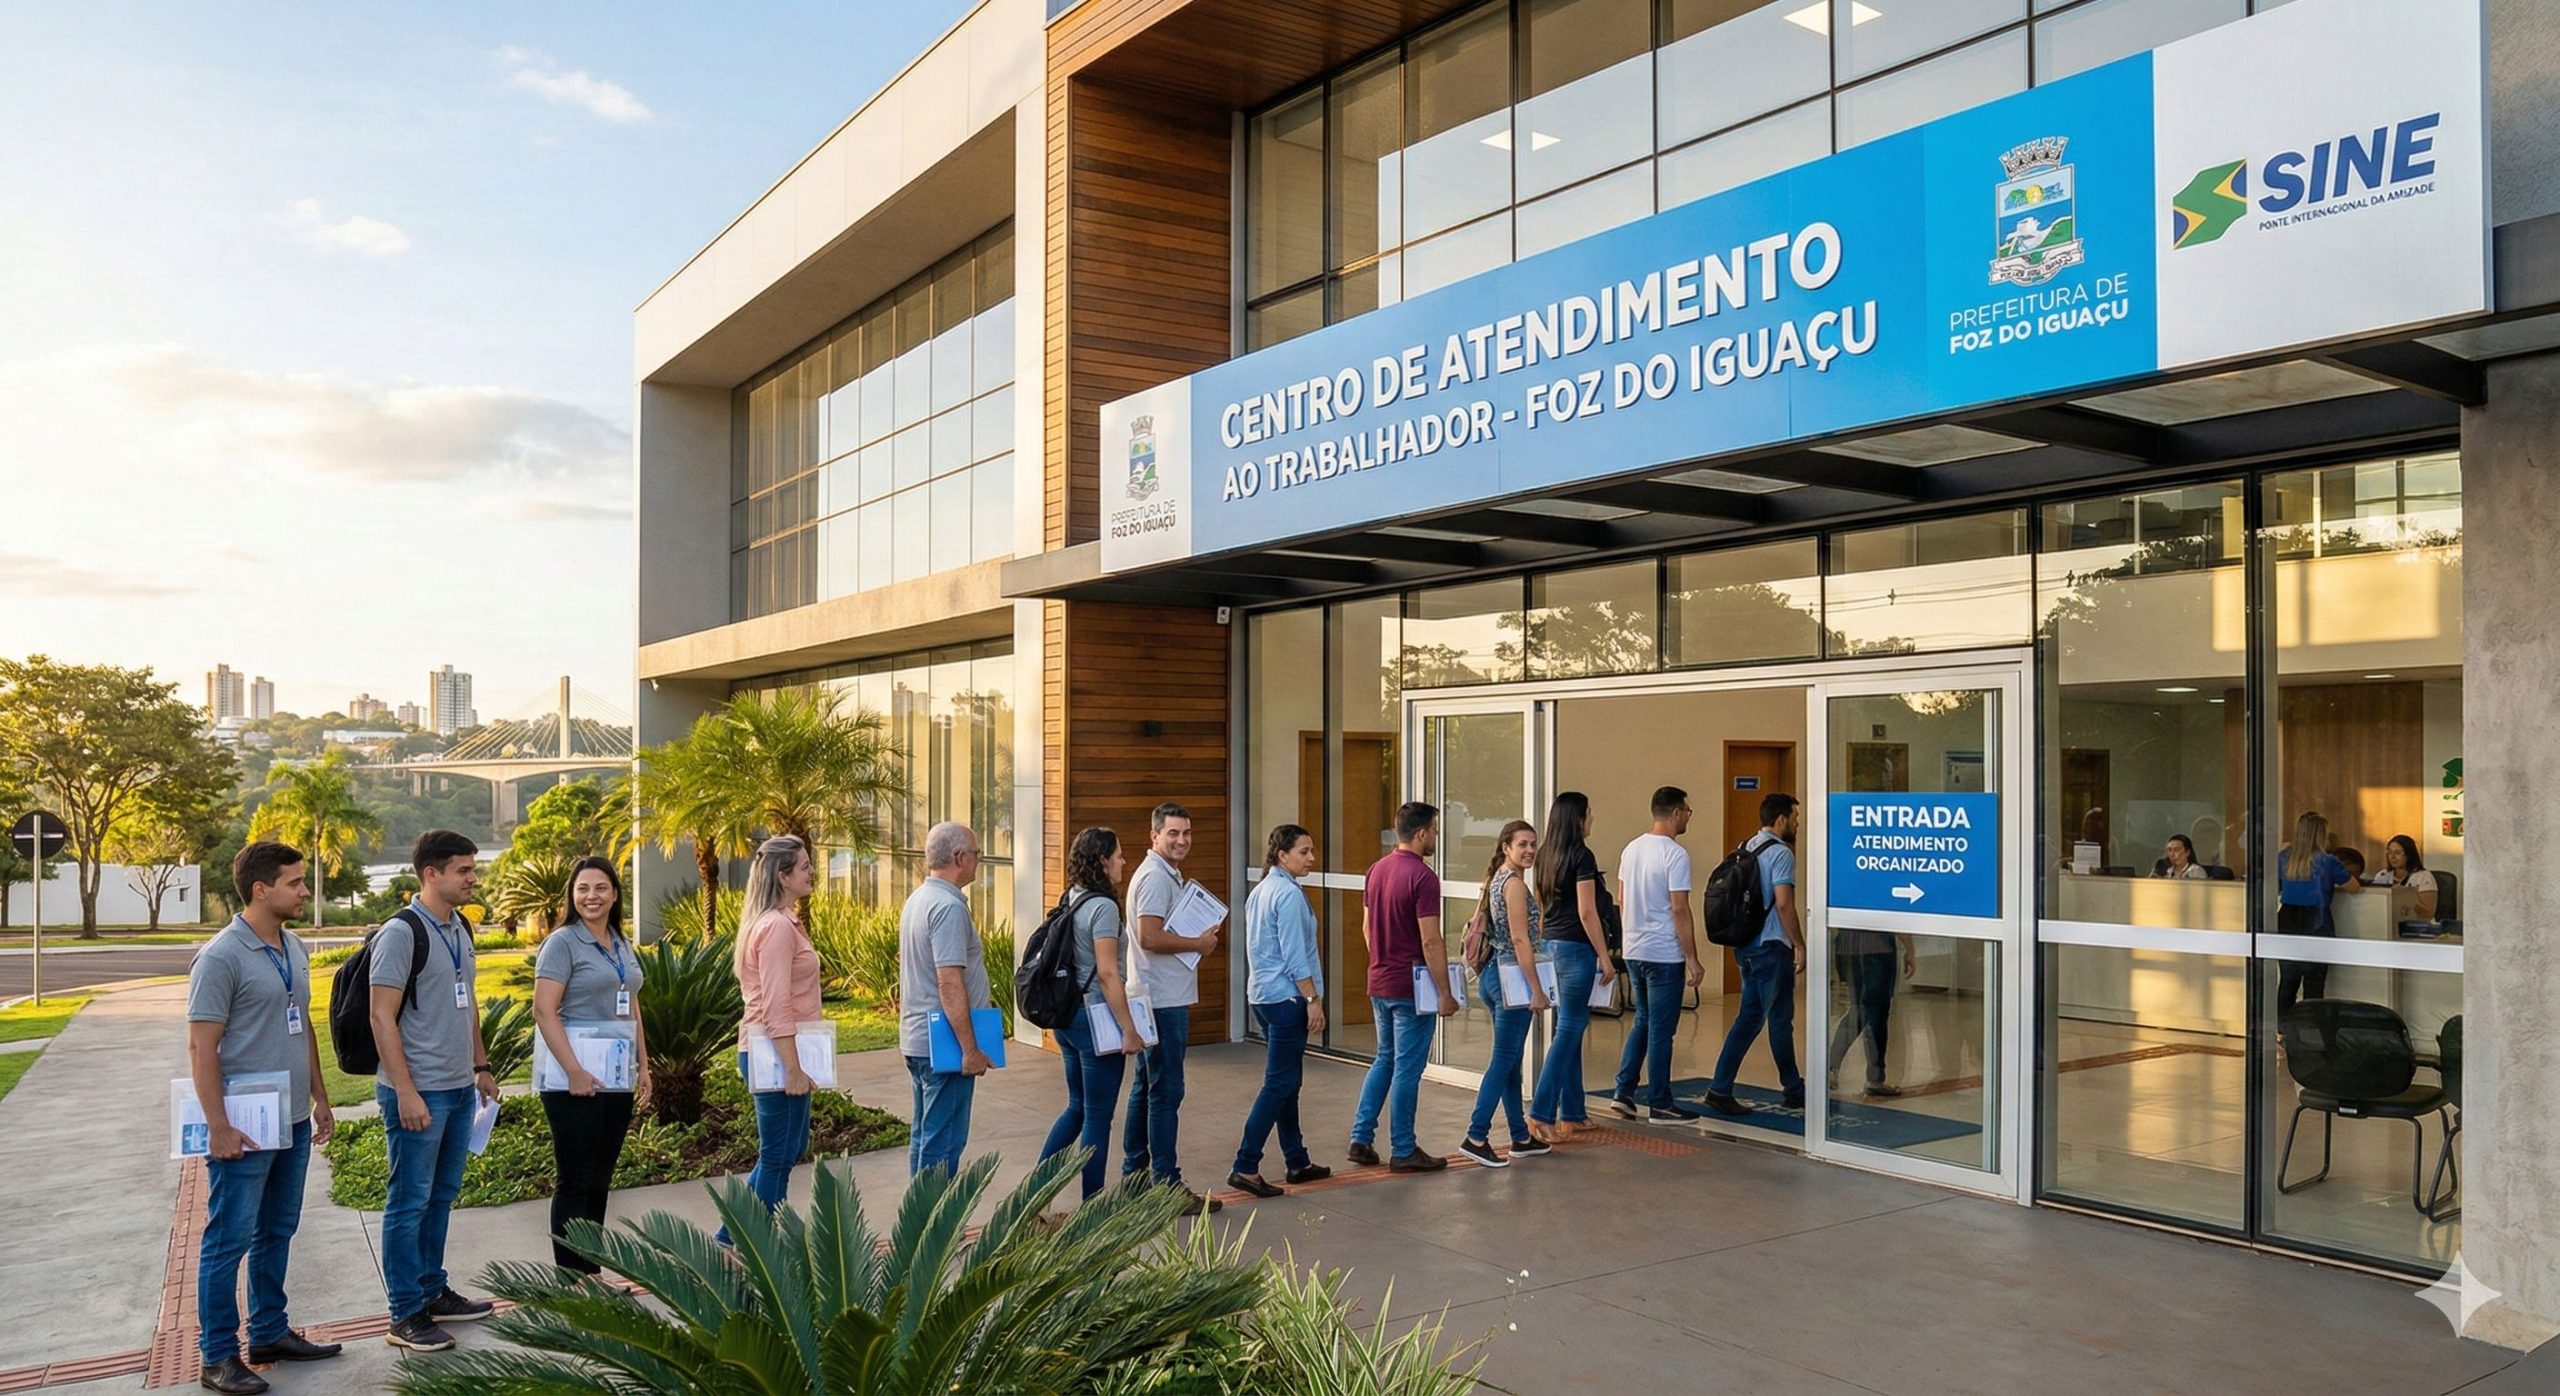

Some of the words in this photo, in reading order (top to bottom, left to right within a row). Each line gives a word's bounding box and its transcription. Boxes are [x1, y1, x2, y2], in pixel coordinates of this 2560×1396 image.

[2259, 112, 2440, 213] SINE
[2259, 217, 2289, 231] PONTE
[2371, 195, 2385, 206] DA
[2387, 182, 2435, 202] AMIZADE
[1950, 283, 2089, 332] PREFEITURA
[2096, 273, 2129, 298] DE
[1950, 328, 1993, 355] FOZ
[1999, 320, 2032, 344] DO
[2038, 298, 2129, 336] IGUAÇU
[1220, 367, 1363, 450] CENTRO
[1373, 344, 1428, 409] DE
[1437, 221, 1843, 391] ATENDIMENTO
[1222, 461, 1261, 502] AO
[1264, 400, 1496, 491] TRABALHADOR
[1527, 370, 1604, 429] FOZ
[1615, 353, 1678, 410] DO
[1690, 300, 1879, 393] IGUAÇU
[1111, 524, 1128, 539] FOZ
[1129, 521, 1142, 535] DO
[1143, 514, 1176, 533] IGUAÇU
[1163, 499, 1176, 514] DE
[1850, 805, 1971, 829] ENTRADA
[1852, 834, 1969, 853] ATENDIMENTO
[1855, 855, 1965, 874] ORGANIZADO
